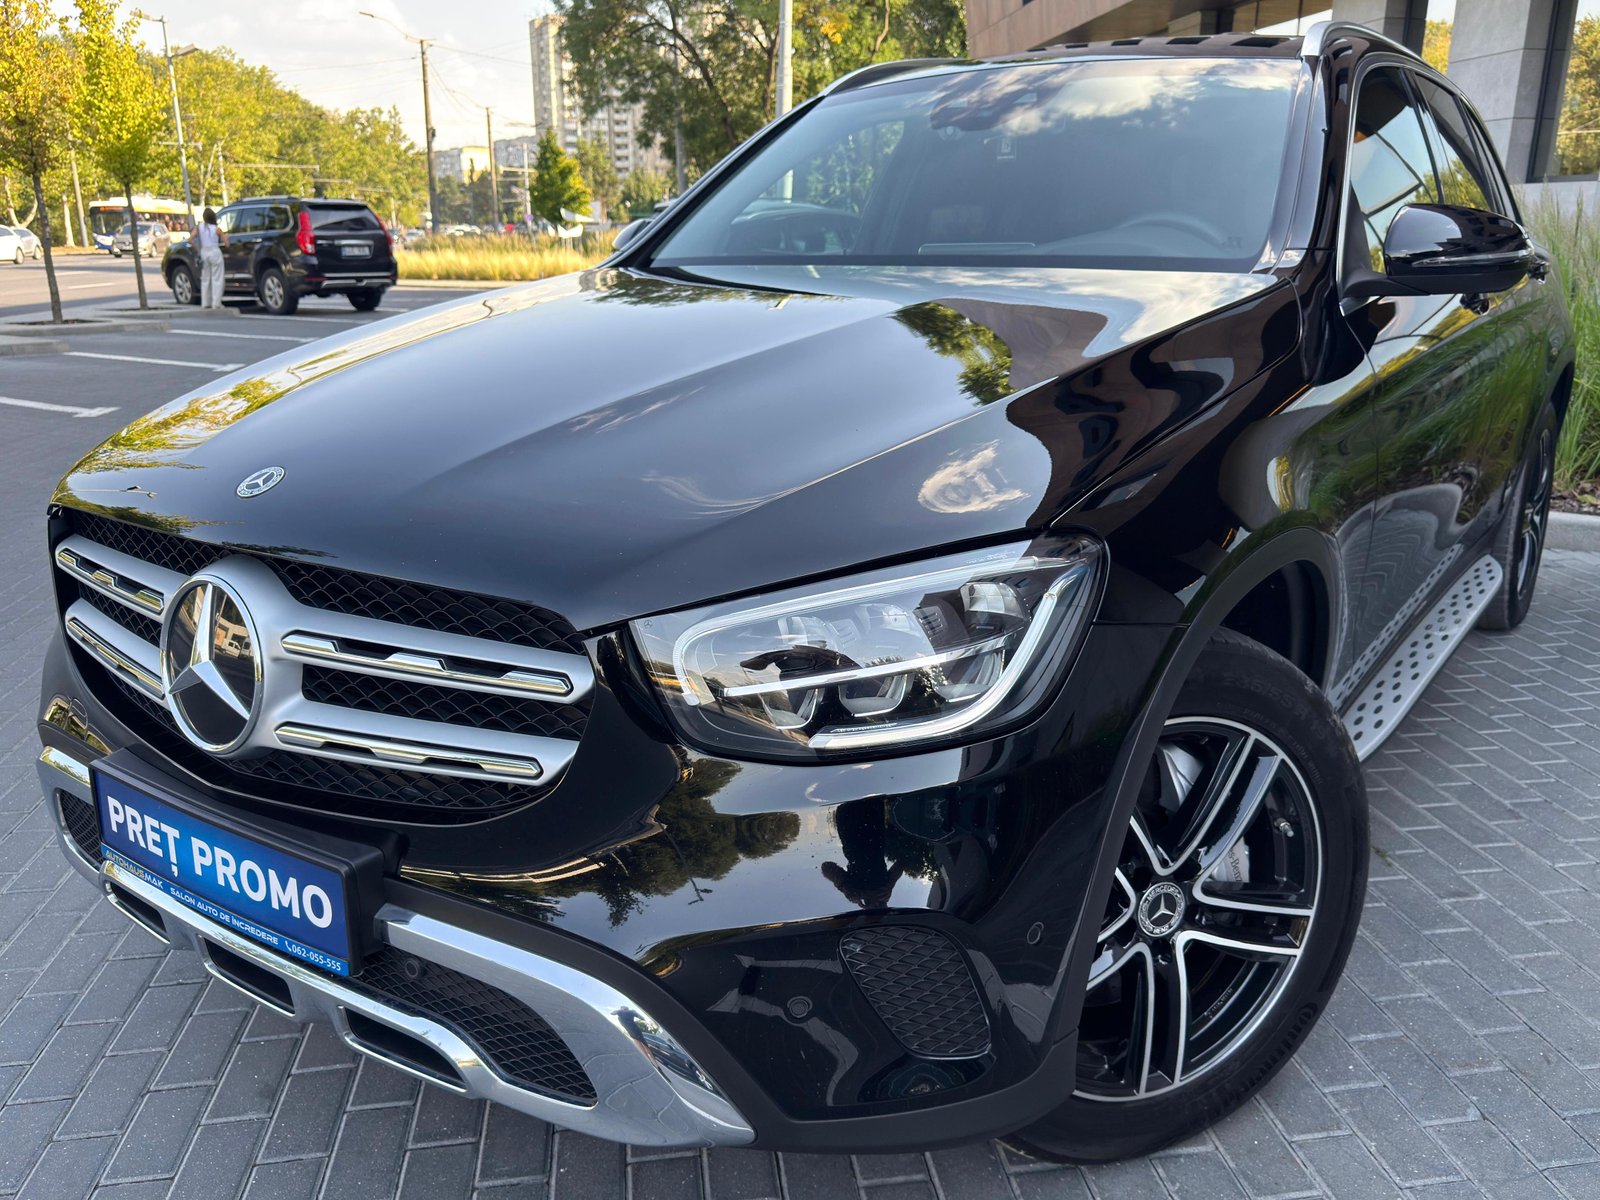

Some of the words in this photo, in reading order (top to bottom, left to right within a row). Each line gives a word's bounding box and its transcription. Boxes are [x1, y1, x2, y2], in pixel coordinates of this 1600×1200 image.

[107, 796, 179, 877] PREȚ
[191, 837, 332, 928] PROMO
[170, 887, 196, 906] SALON
[197, 901, 218, 917] AUTO
[220, 912, 230, 922] DE
[292, 944, 341, 971] 062-055-555
